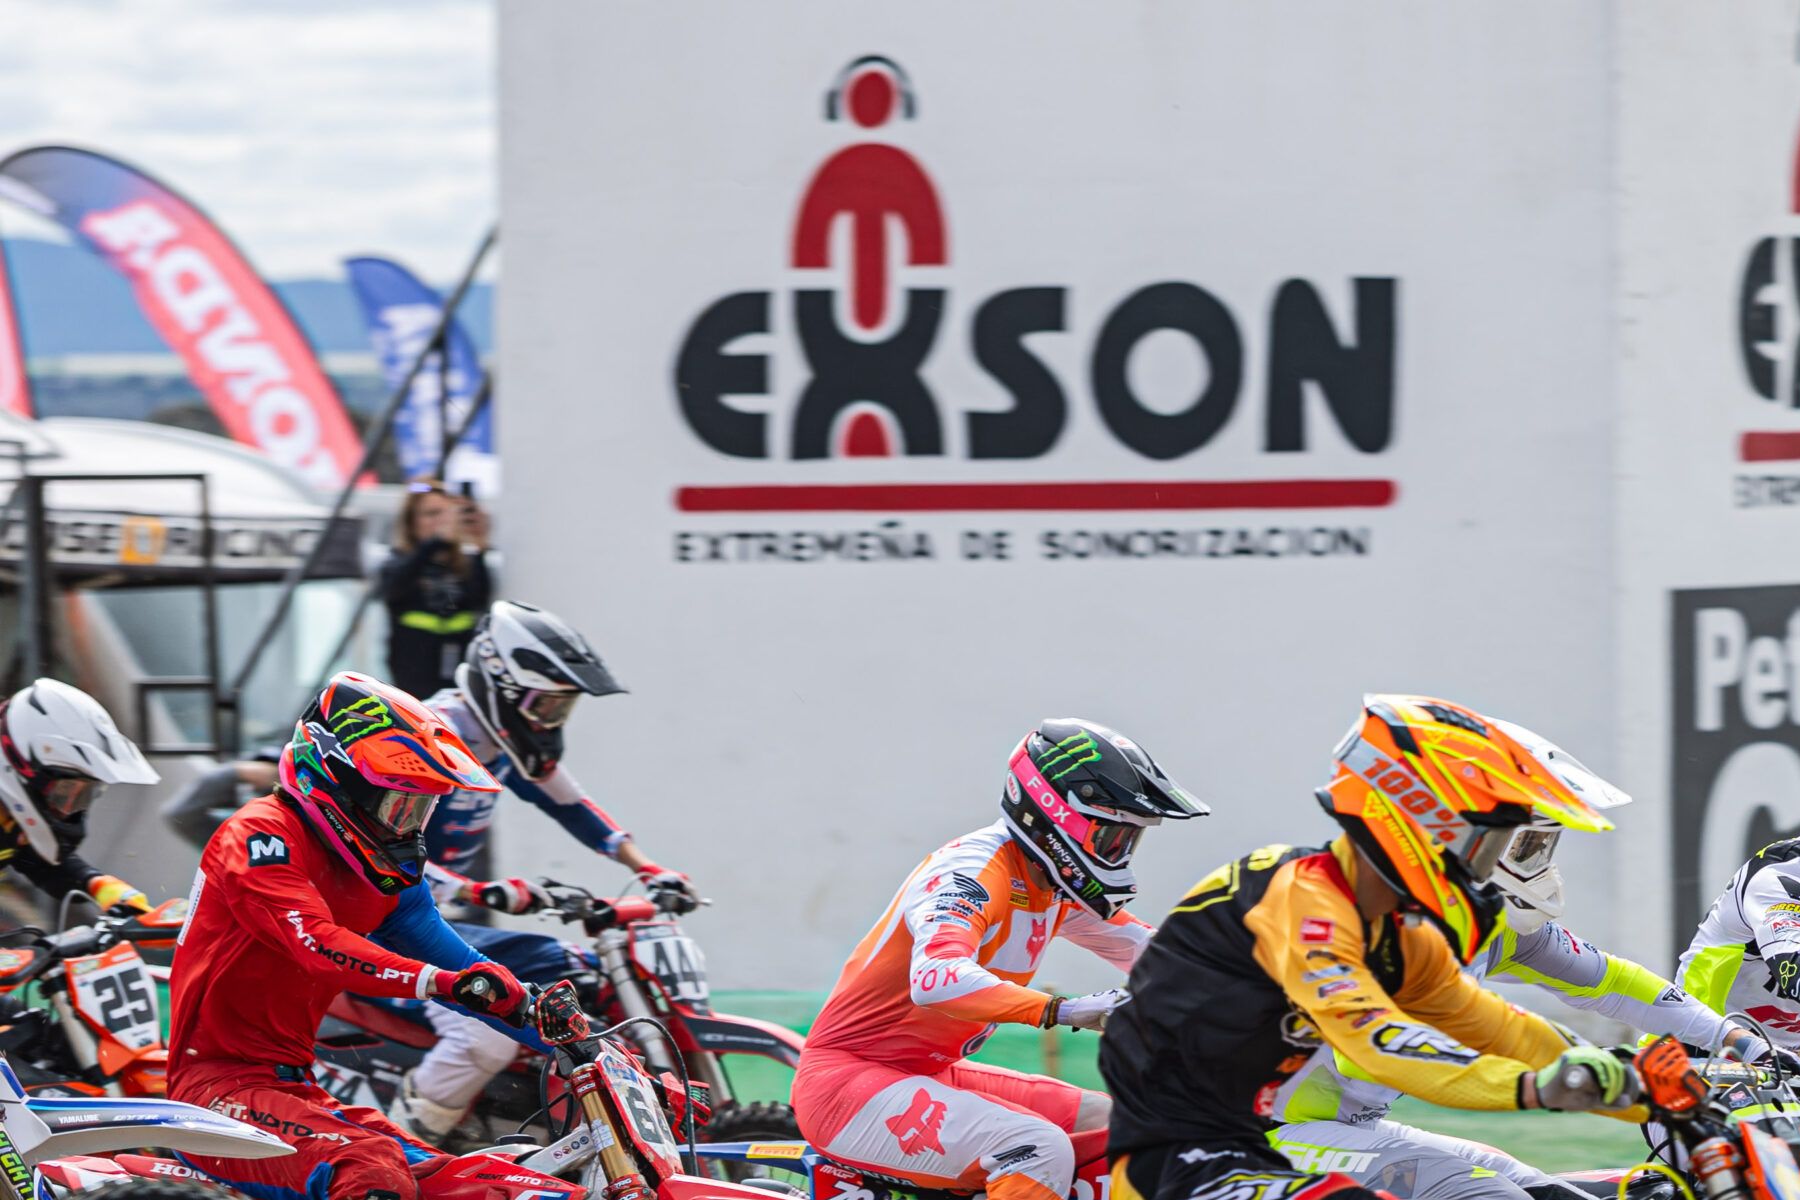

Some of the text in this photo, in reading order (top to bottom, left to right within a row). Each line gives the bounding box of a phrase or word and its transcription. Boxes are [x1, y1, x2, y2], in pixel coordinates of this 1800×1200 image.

[674, 277, 1400, 461] EXSON
[674, 520, 1372, 562] EXTREMEÑA DE SONORIZACION
[1026, 775, 1071, 824] FOX
[1363, 756, 1466, 843] 100%
[1045, 832, 1086, 881] MONSTER
[939, 891, 984, 912] HONDA
[92, 967, 155, 1034] 25
[57, 1113, 100, 1125] YAMALUBE
[1277, 1145, 1382, 1174] SHOT
